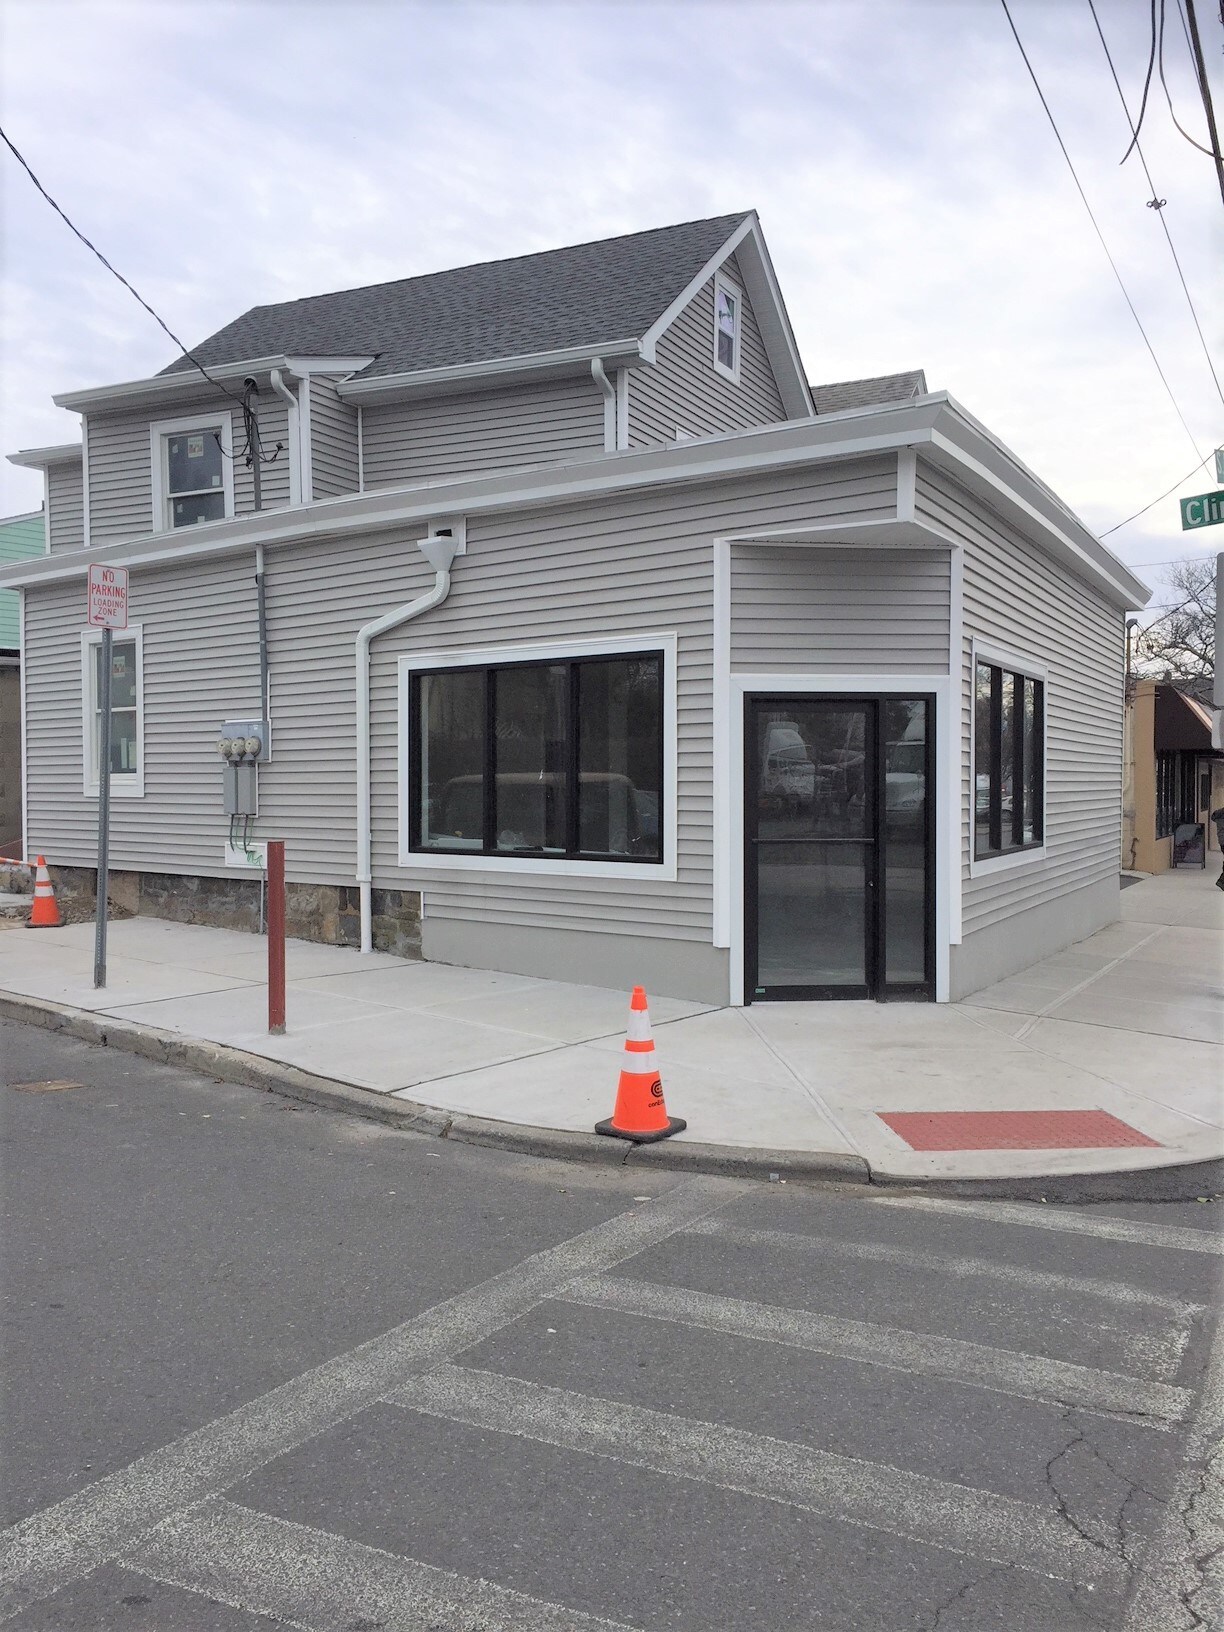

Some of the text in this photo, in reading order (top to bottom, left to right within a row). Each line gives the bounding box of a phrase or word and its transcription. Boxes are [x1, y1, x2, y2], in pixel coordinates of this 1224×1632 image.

[102, 570, 115, 583] NO
[91, 582, 126, 599] PARKING
[93, 597, 124, 609] LOADING
[98, 606, 118, 617] ZONE
